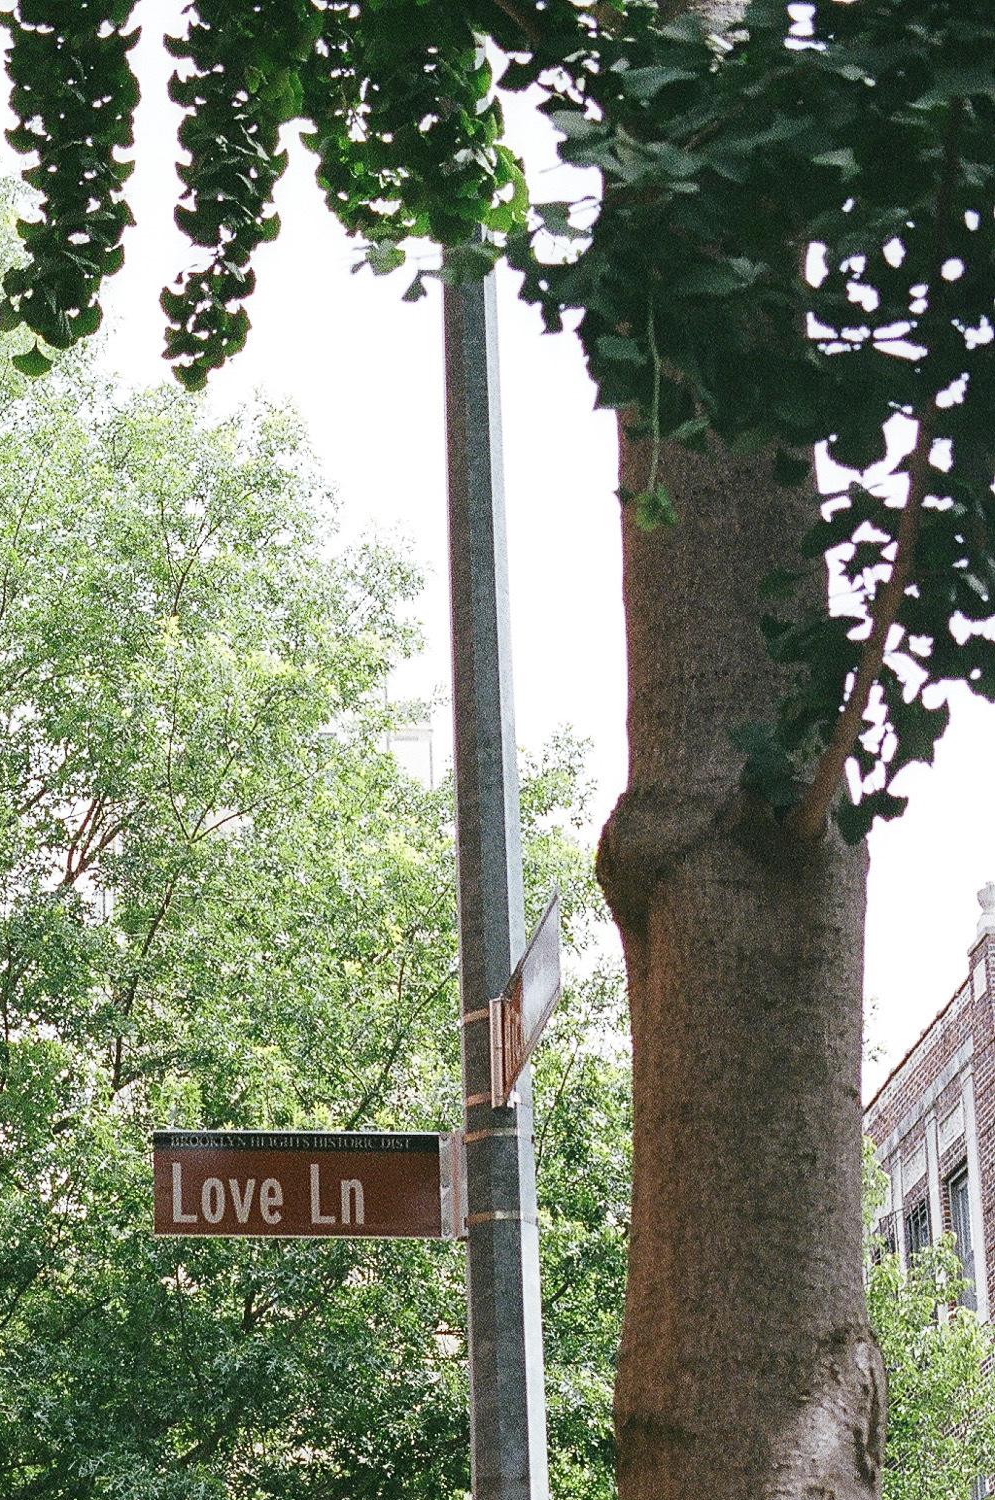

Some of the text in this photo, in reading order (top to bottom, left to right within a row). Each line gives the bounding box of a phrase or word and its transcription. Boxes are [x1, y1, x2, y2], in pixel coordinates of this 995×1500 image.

[169, 1136, 246, 1148] BROOKLYN
[250, 1137, 310, 1148] HEIGHTS
[313, 1137, 375, 1149] HISTORIC
[171, 1162, 365, 1225] Love Ln
